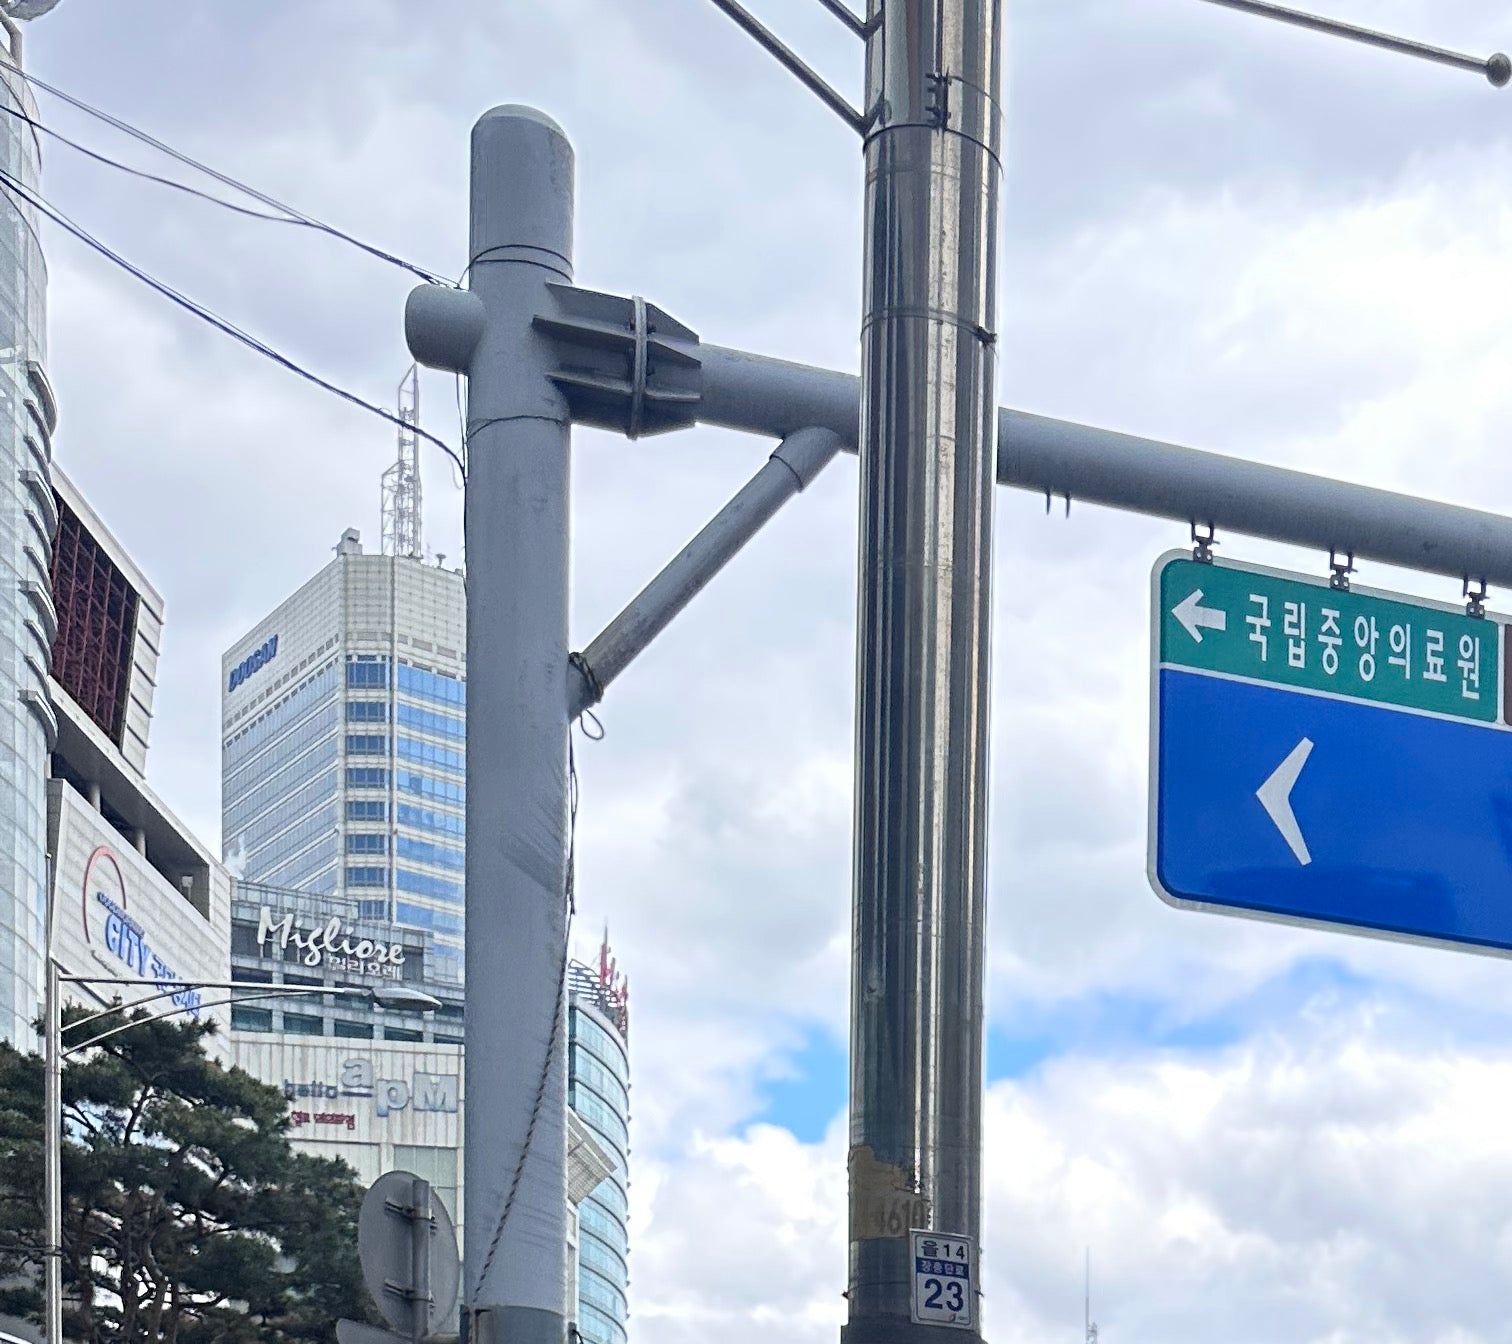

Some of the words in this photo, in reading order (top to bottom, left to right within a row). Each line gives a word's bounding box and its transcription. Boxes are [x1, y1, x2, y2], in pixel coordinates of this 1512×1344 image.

[228, 634, 278, 692] DOOSAN
[1245, 593, 1482, 701] 국립중앙의료원
[105, 913, 151, 978] CITY
[257, 906, 406, 967] Migliore
[924, 1278, 964, 1312] 23
